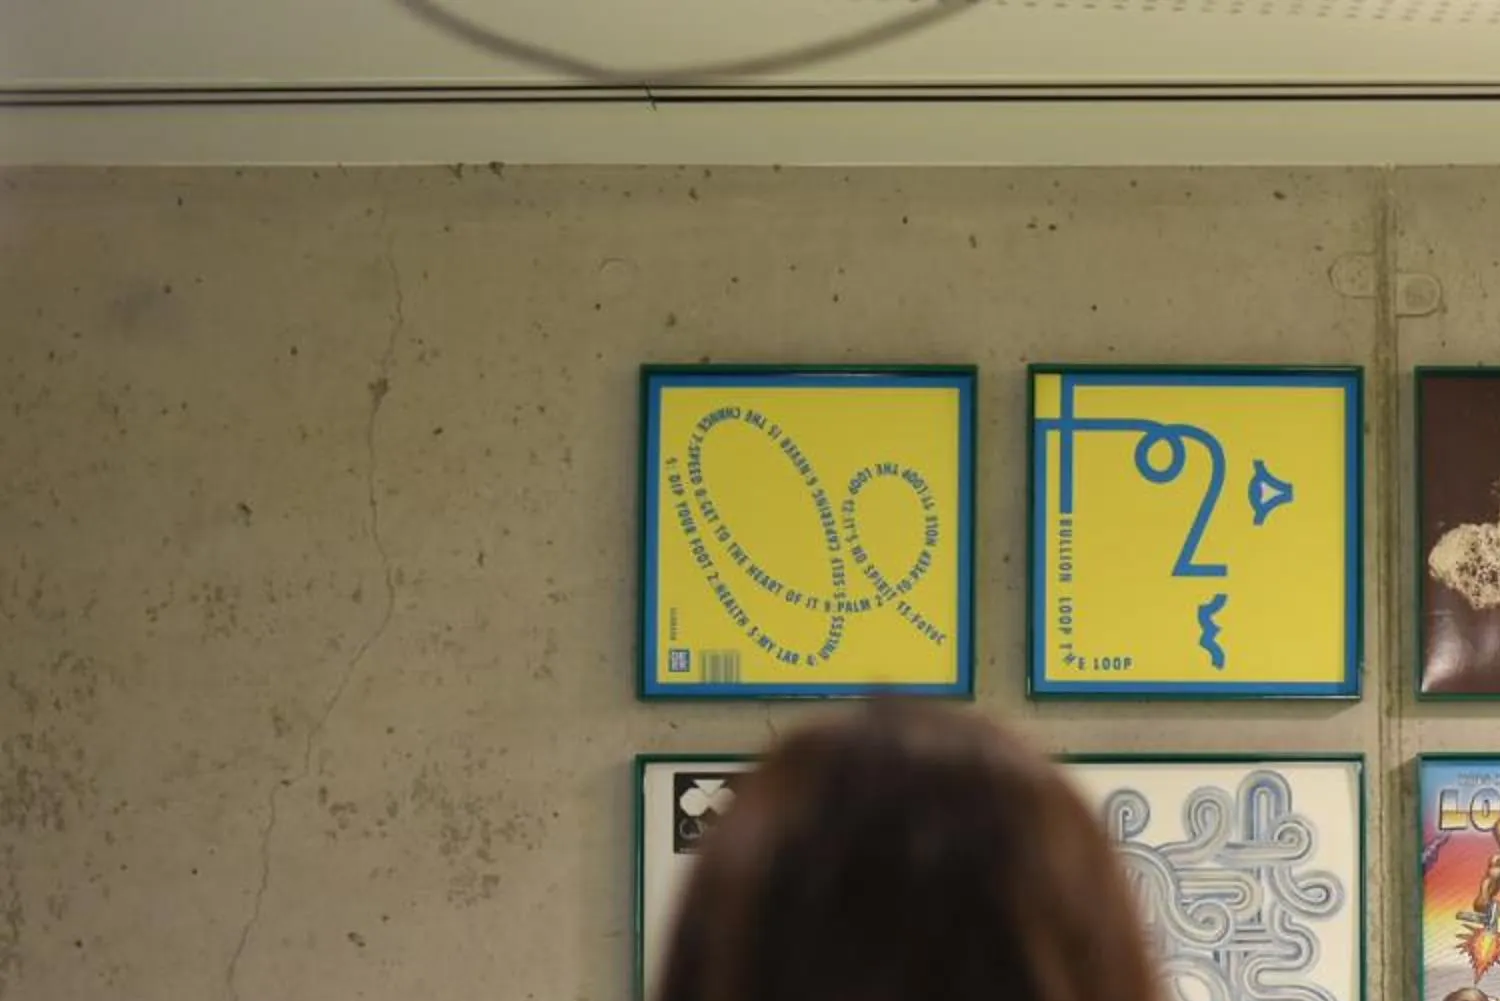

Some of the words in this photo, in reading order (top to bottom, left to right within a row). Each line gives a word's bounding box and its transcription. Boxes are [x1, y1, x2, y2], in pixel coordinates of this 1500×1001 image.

[744, 409, 768, 430] THE
[848, 467, 873, 495] LOOP
[875, 463, 899, 476] THE
[714, 524, 731, 542] TO
[925, 515, 939, 547] HOLE
[689, 538, 713, 569] FOOT
[727, 542, 750, 565] THE
[1058, 519, 1073, 583] BULLION
[745, 563, 784, 595] HEART
[785, 588, 803, 605] OF
[1058, 596, 1073, 635] LOOP
[1093, 656, 1133, 671] LOOP
